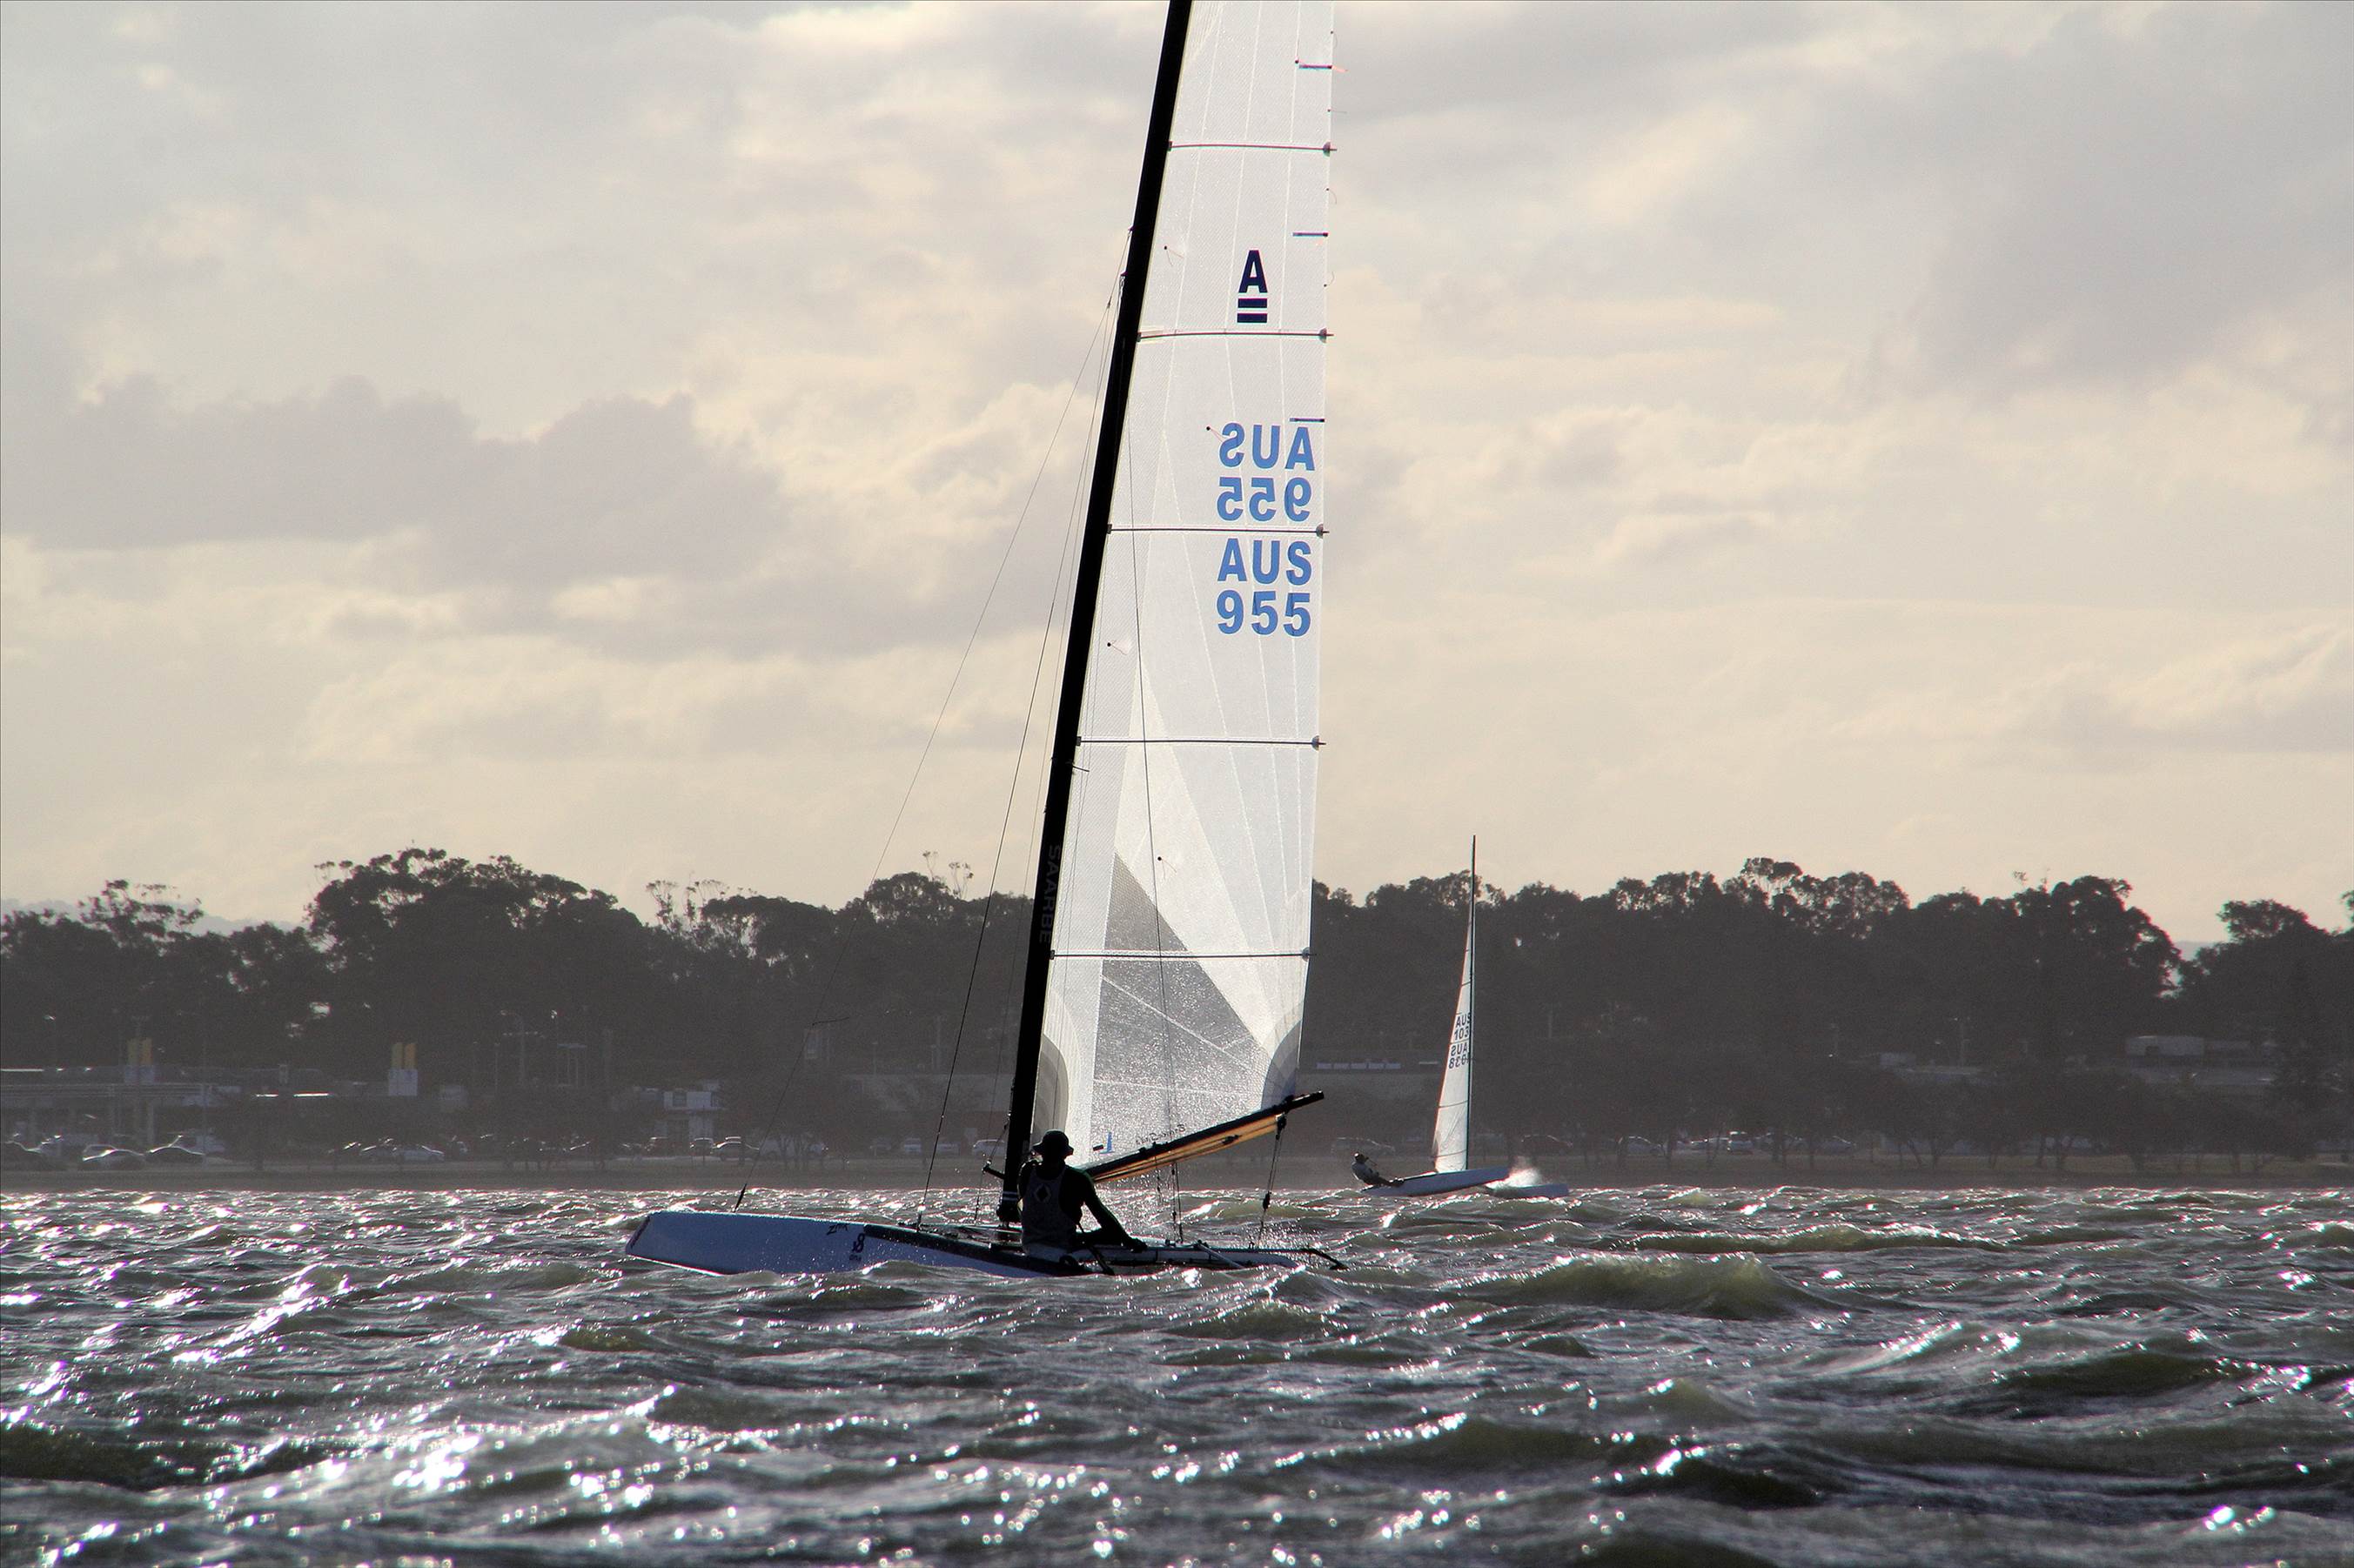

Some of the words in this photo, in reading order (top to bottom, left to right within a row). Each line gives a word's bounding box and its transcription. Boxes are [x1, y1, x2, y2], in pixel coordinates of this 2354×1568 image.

[1238, 250, 1268, 293] A
[1217, 538, 1311, 585] AUS
[1217, 590, 1311, 636] 955
